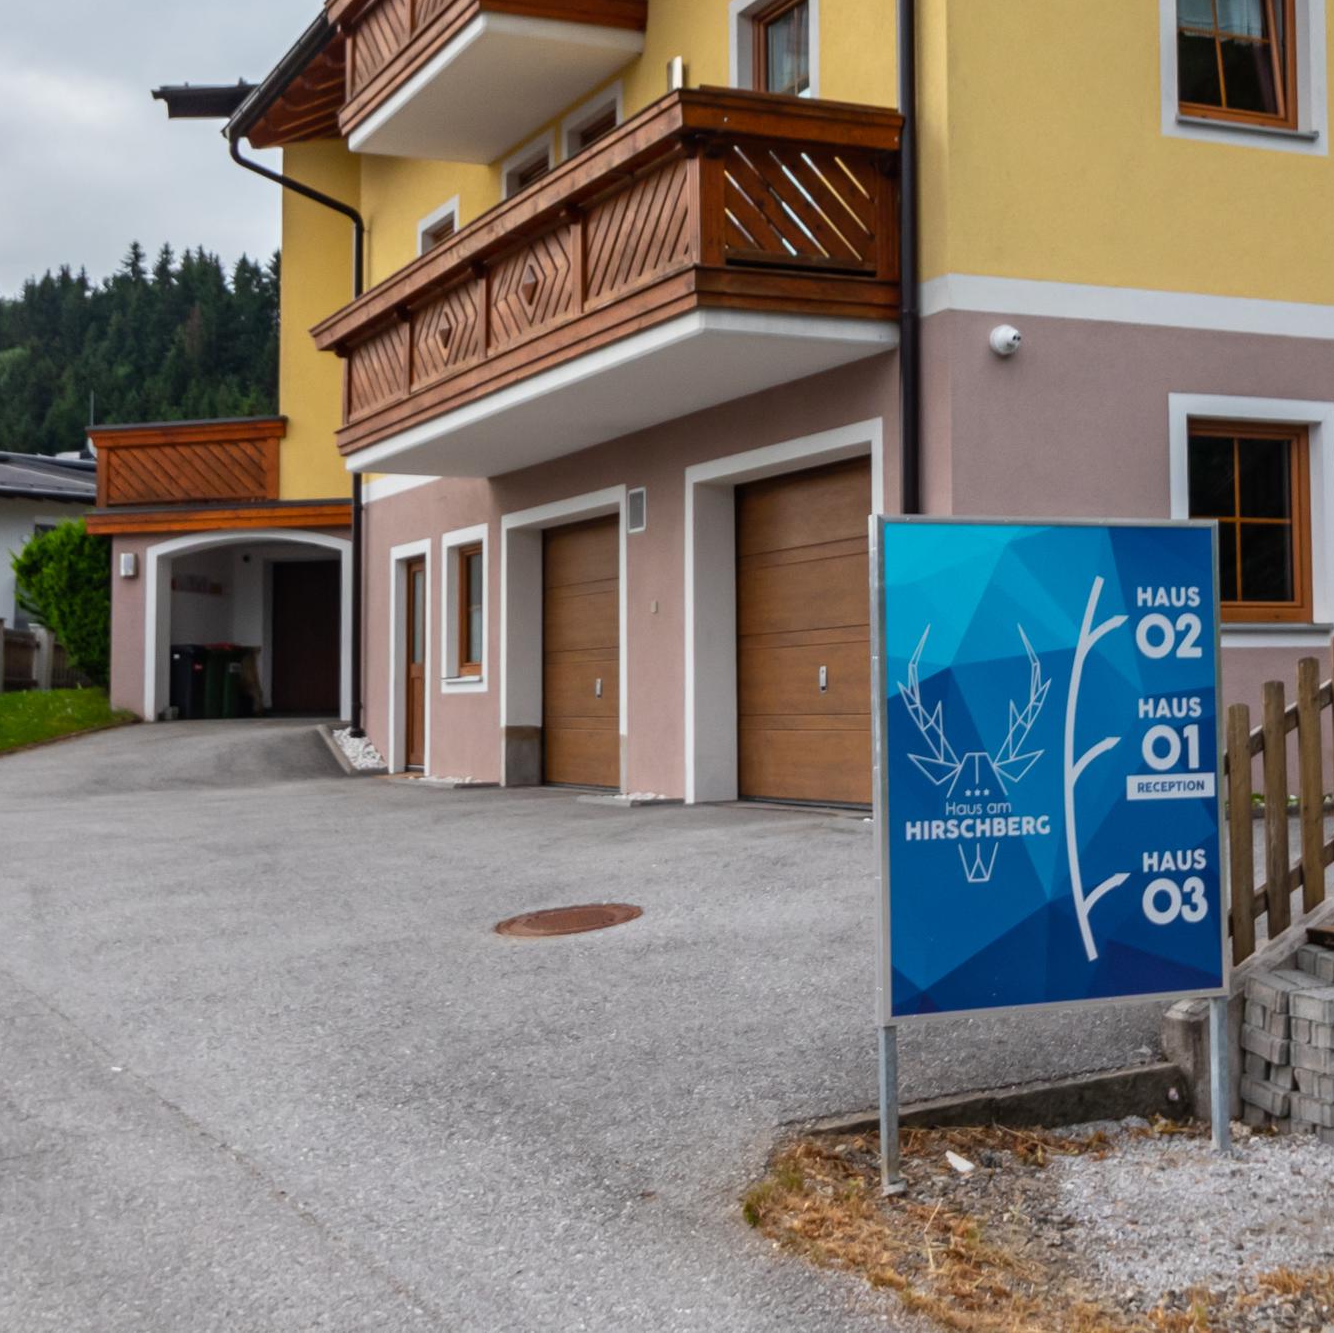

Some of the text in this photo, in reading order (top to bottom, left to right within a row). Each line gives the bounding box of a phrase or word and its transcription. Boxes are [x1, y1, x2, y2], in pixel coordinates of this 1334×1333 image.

[1137, 586, 1201, 607] HAUS
[1136, 613, 1202, 658] 02
[1138, 697, 1202, 719] HAUS
[1142, 724, 1200, 770] 01
[1137, 779, 1205, 793] RECEPTION
[945, 801, 1012, 815] Haus am
[905, 815, 1051, 840] HIRSCHBERG
[1142, 848, 1207, 872] HAUS
[1142, 876, 1208, 924] 03
